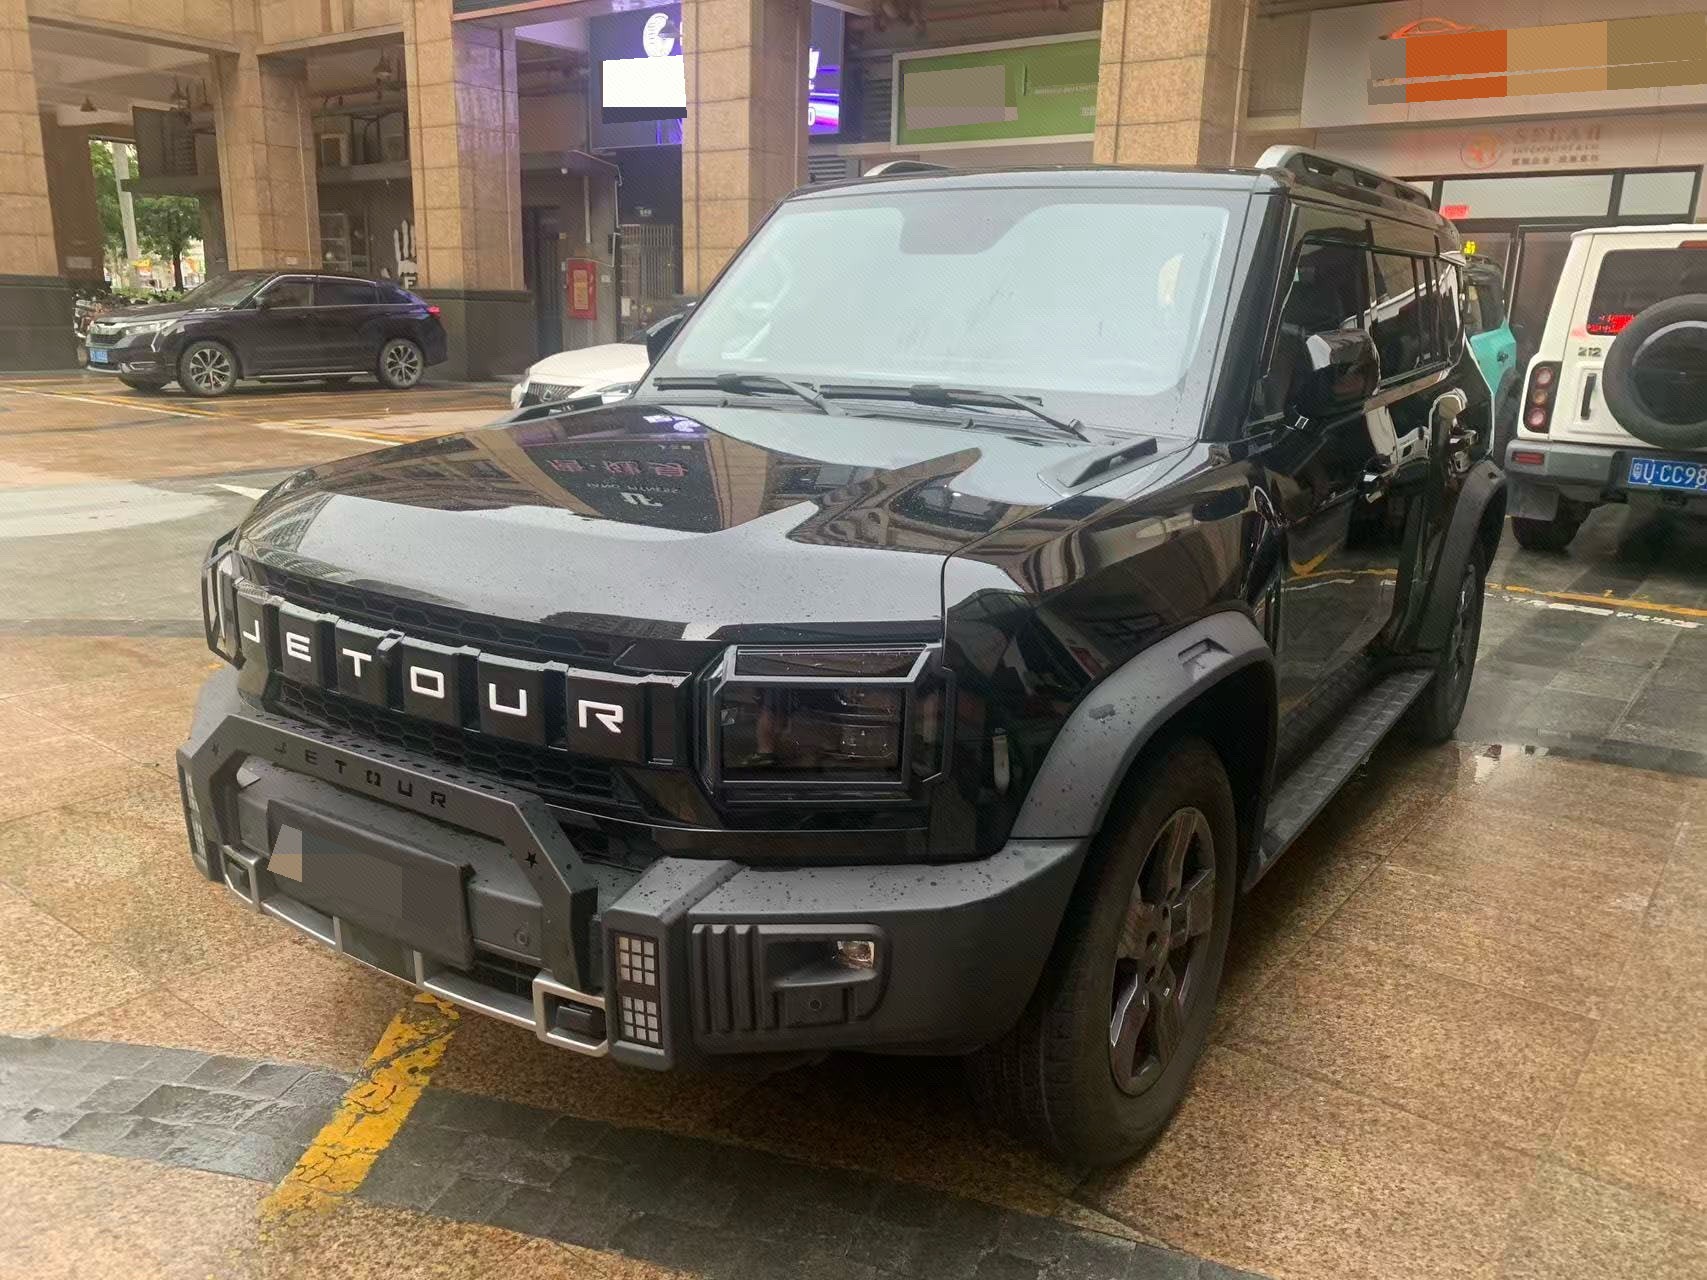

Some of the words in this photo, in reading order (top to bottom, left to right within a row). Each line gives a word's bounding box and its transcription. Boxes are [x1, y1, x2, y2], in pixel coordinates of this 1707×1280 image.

[1578, 346, 1602, 357] 212
[243, 619, 624, 734] JETOUR
[274, 742, 447, 808] JETOUR
